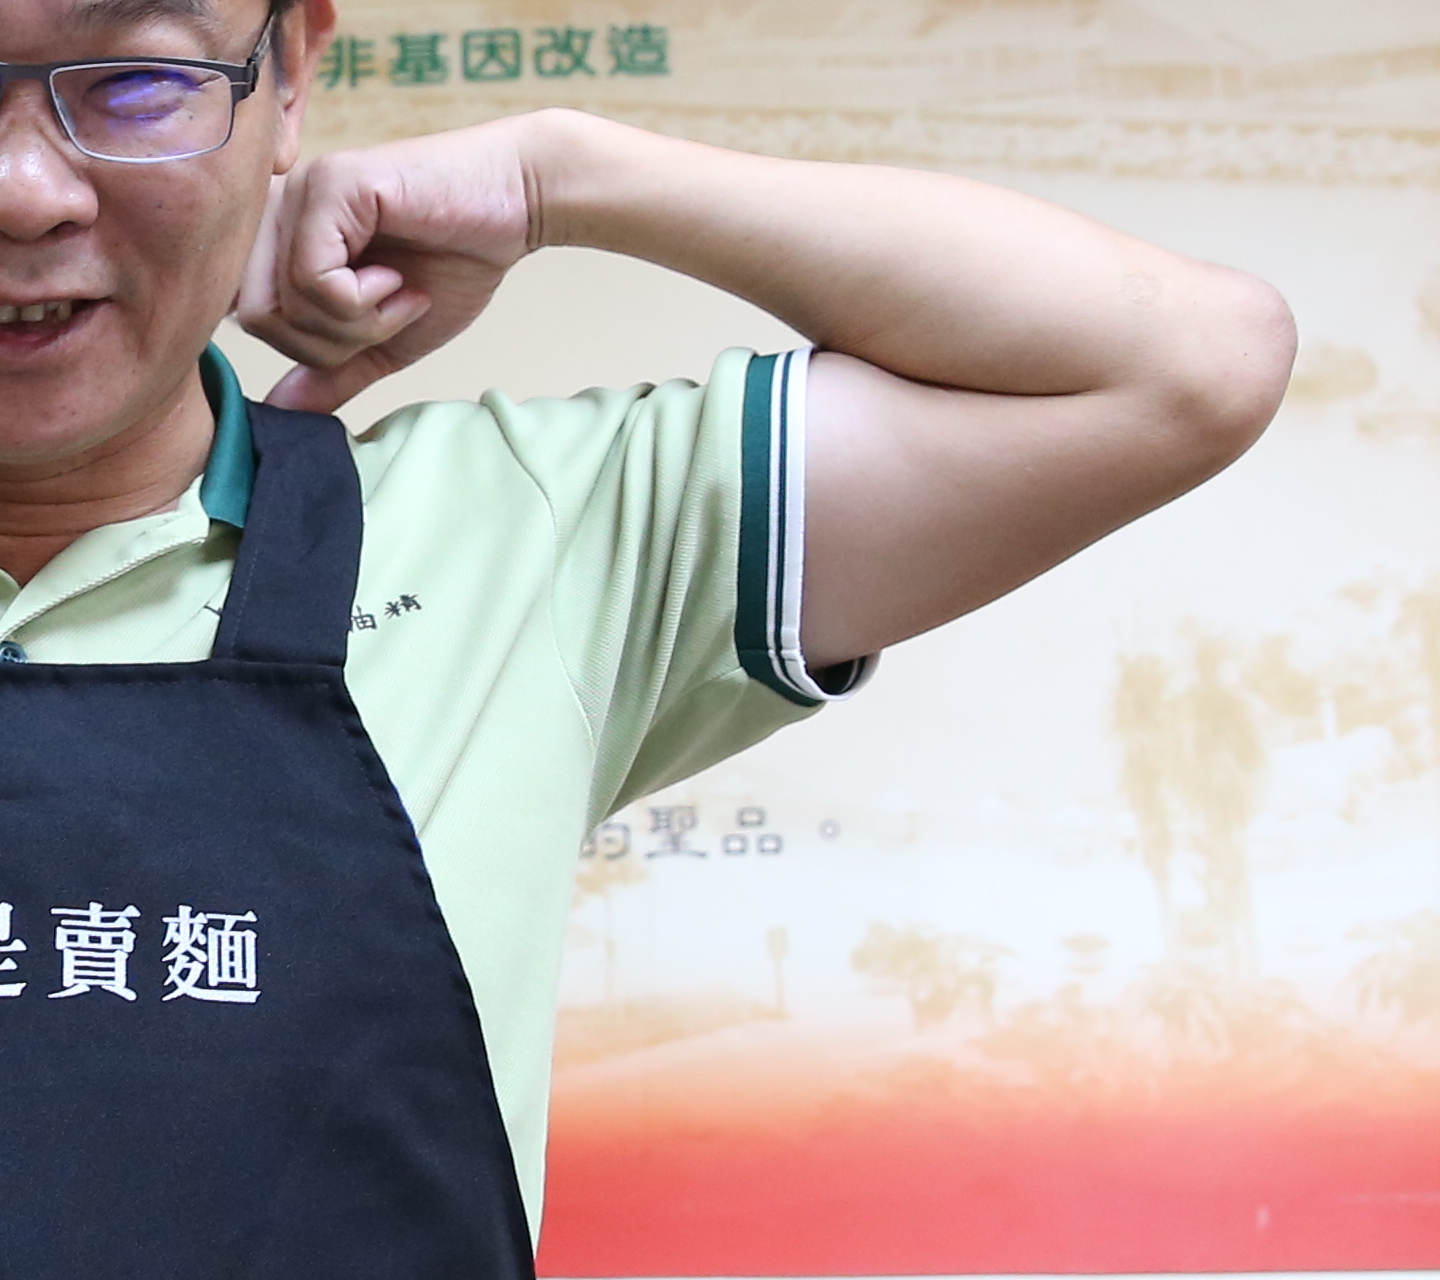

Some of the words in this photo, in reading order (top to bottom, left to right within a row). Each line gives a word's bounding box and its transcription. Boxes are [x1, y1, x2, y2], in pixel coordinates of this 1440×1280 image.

[318, 24, 672, 90] 非基因改造
